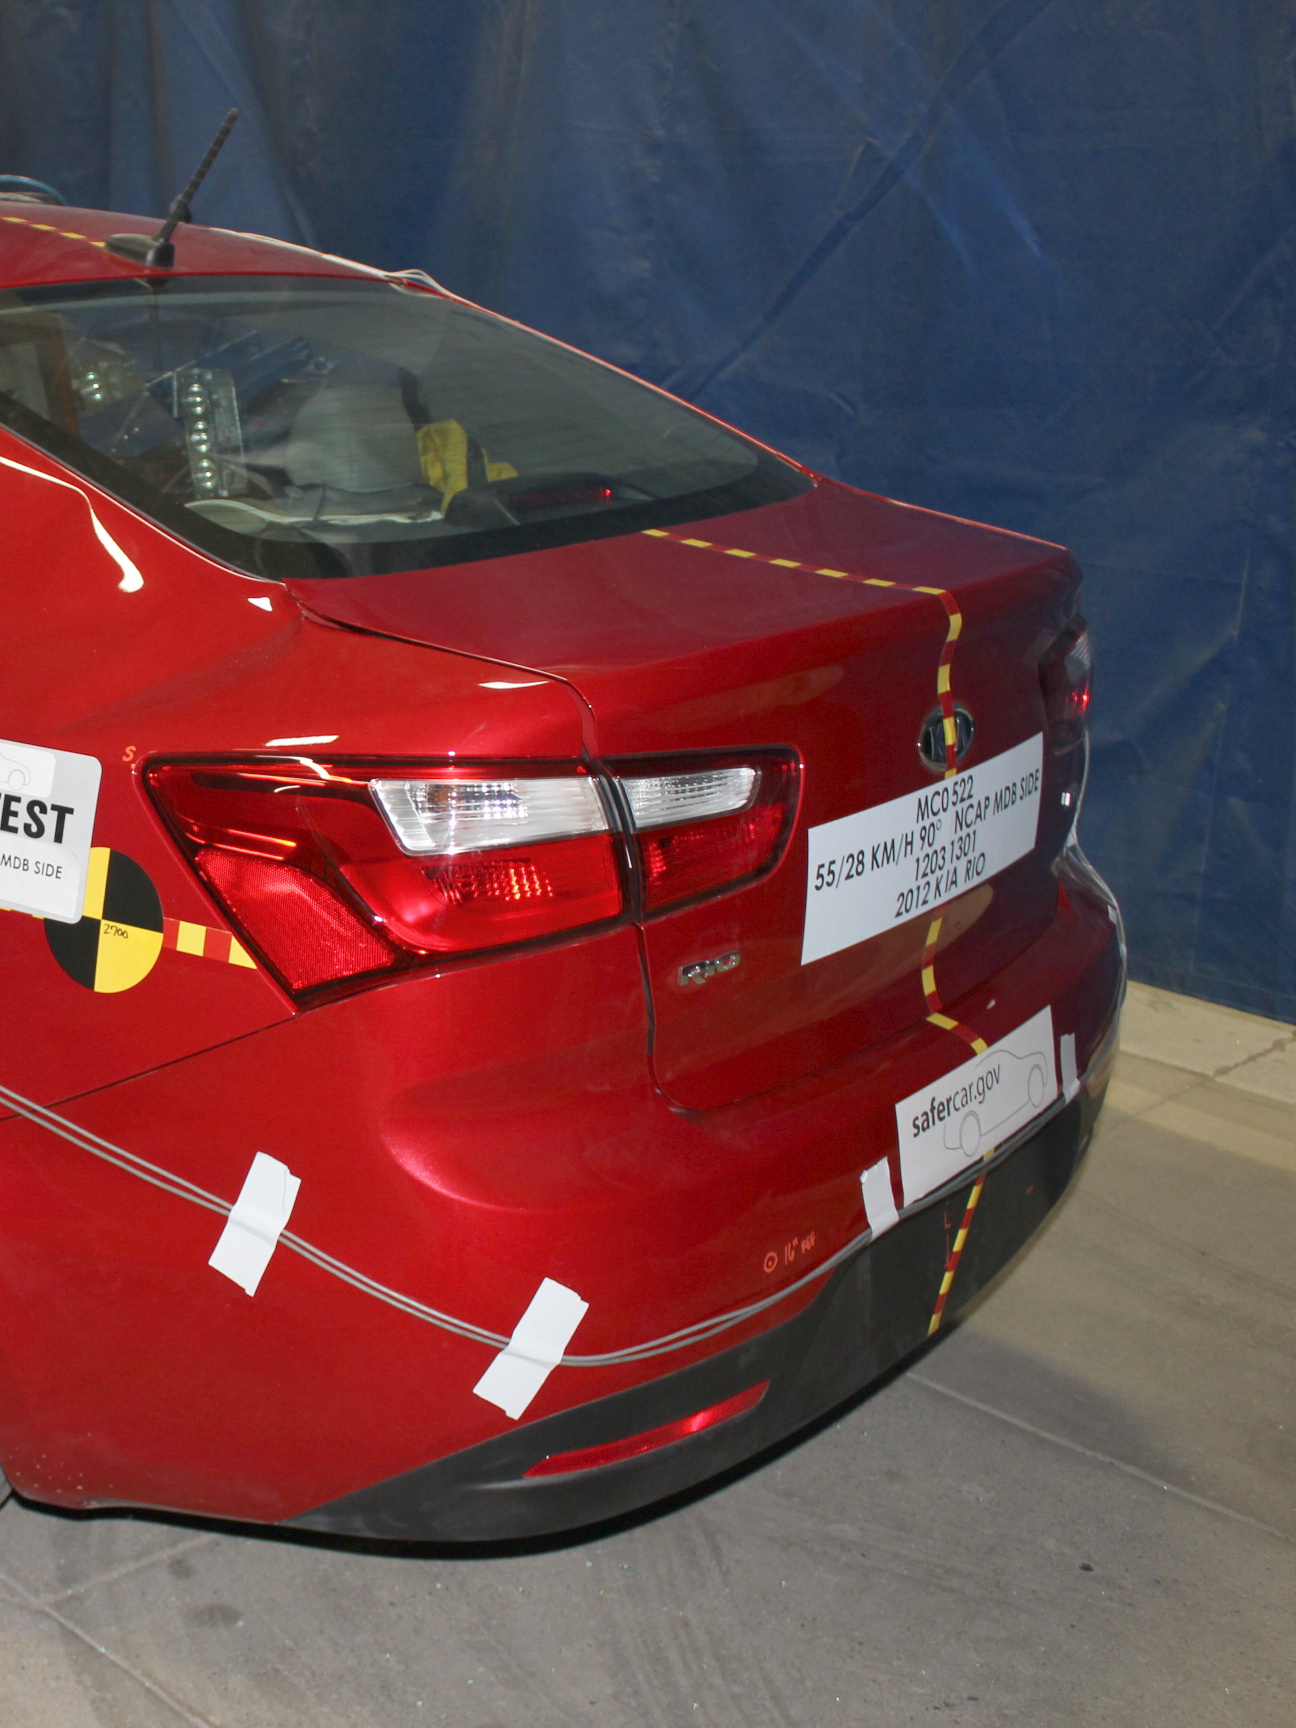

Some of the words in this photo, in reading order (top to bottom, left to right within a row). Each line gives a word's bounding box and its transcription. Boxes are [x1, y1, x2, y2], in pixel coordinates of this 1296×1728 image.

[814, 849, 865, 891] 55/28
[870, 830, 914, 871] KM/H
[954, 795, 991, 834] NCAP
[992, 782, 1017, 816] MDB
[1019, 768, 1040, 801] SIDE
[915, 829, 977, 881] 12031301
[0, 853, 30, 872] MDB
[34, 861, 63, 880] SIDE
[894, 880, 931, 918] 2012
[934, 866, 958, 900] KIA
[964, 852, 986, 884] RIO
[912, 1063, 1001, 1138] safercar.gov
